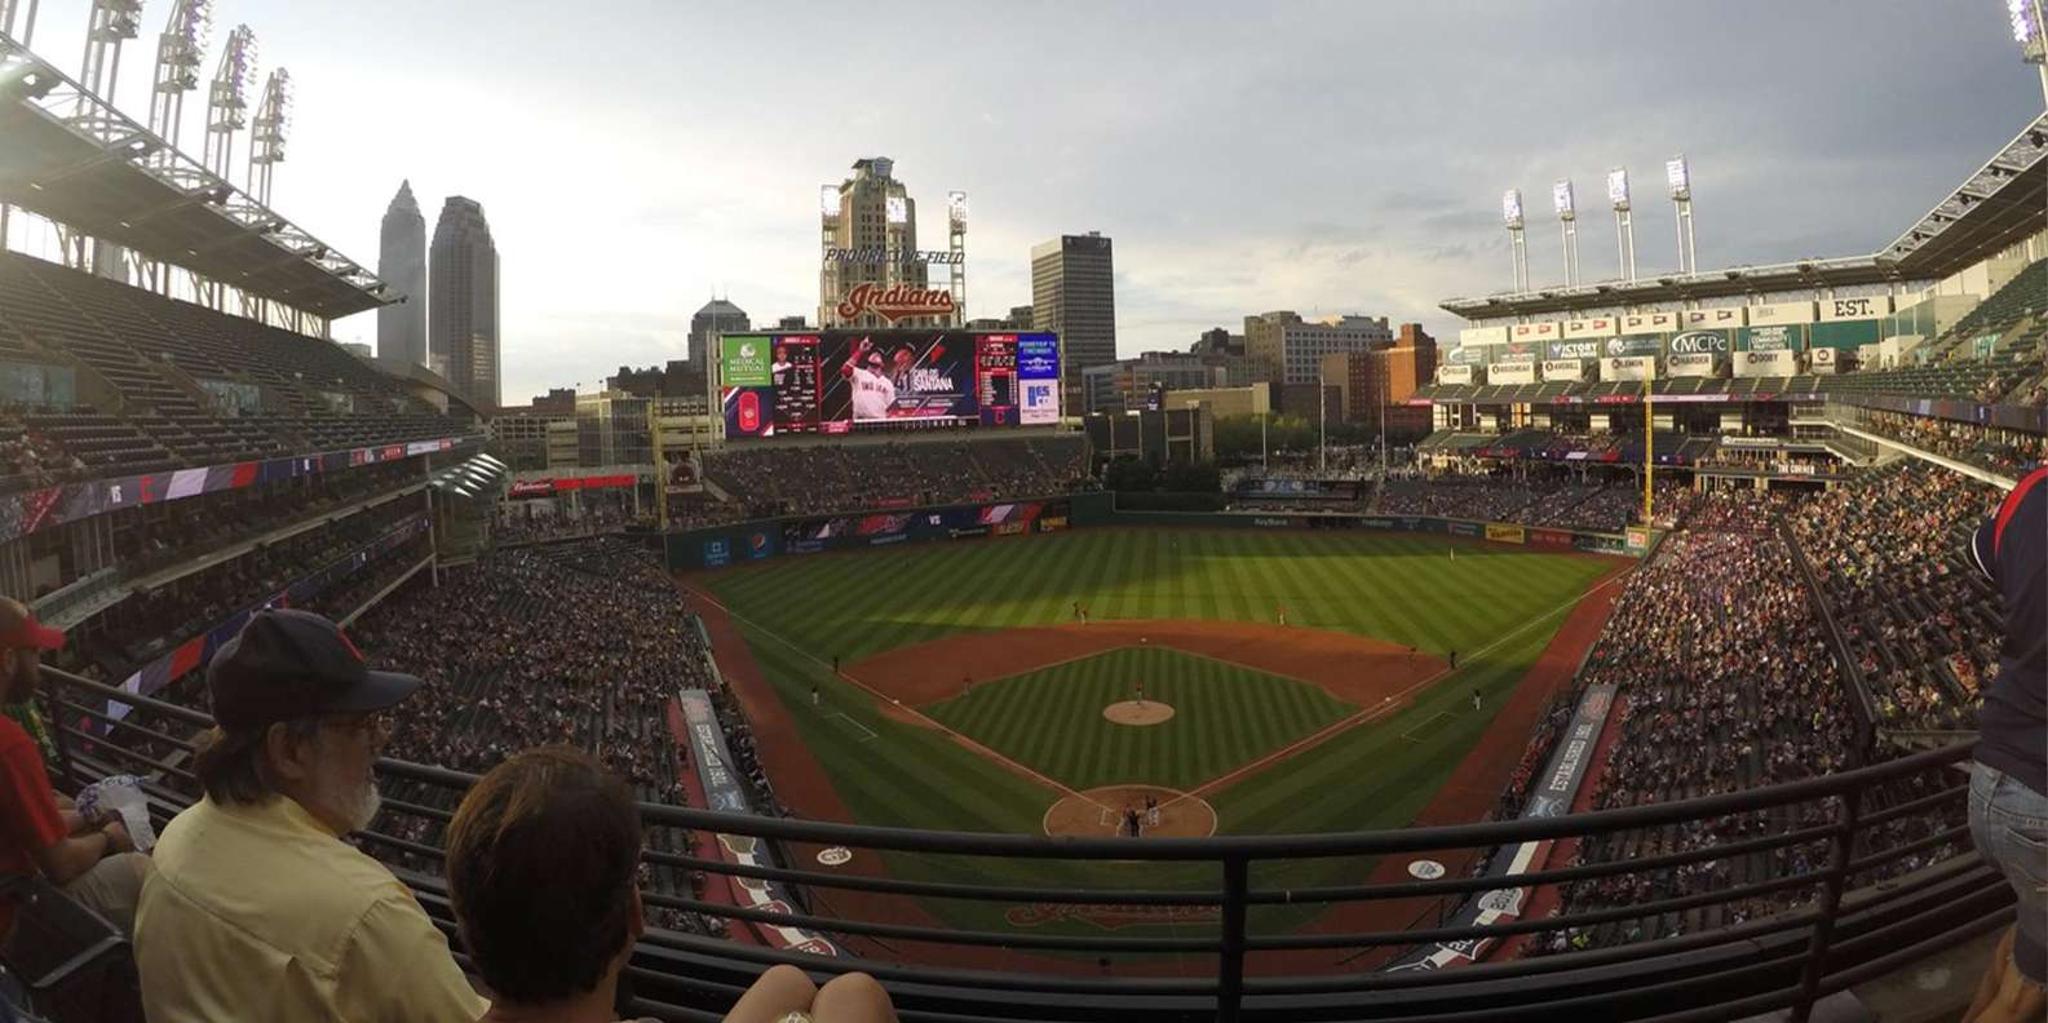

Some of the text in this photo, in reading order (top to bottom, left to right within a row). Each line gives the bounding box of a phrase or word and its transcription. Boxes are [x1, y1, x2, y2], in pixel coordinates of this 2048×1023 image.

[927, 250, 965, 264] FIELD
[838, 282, 955, 321] Indians
[1834, 299, 1875, 317] EST.
[914, 376, 954, 391] SANTANA
[1549, 740, 1587, 791] ESTABLISHED
